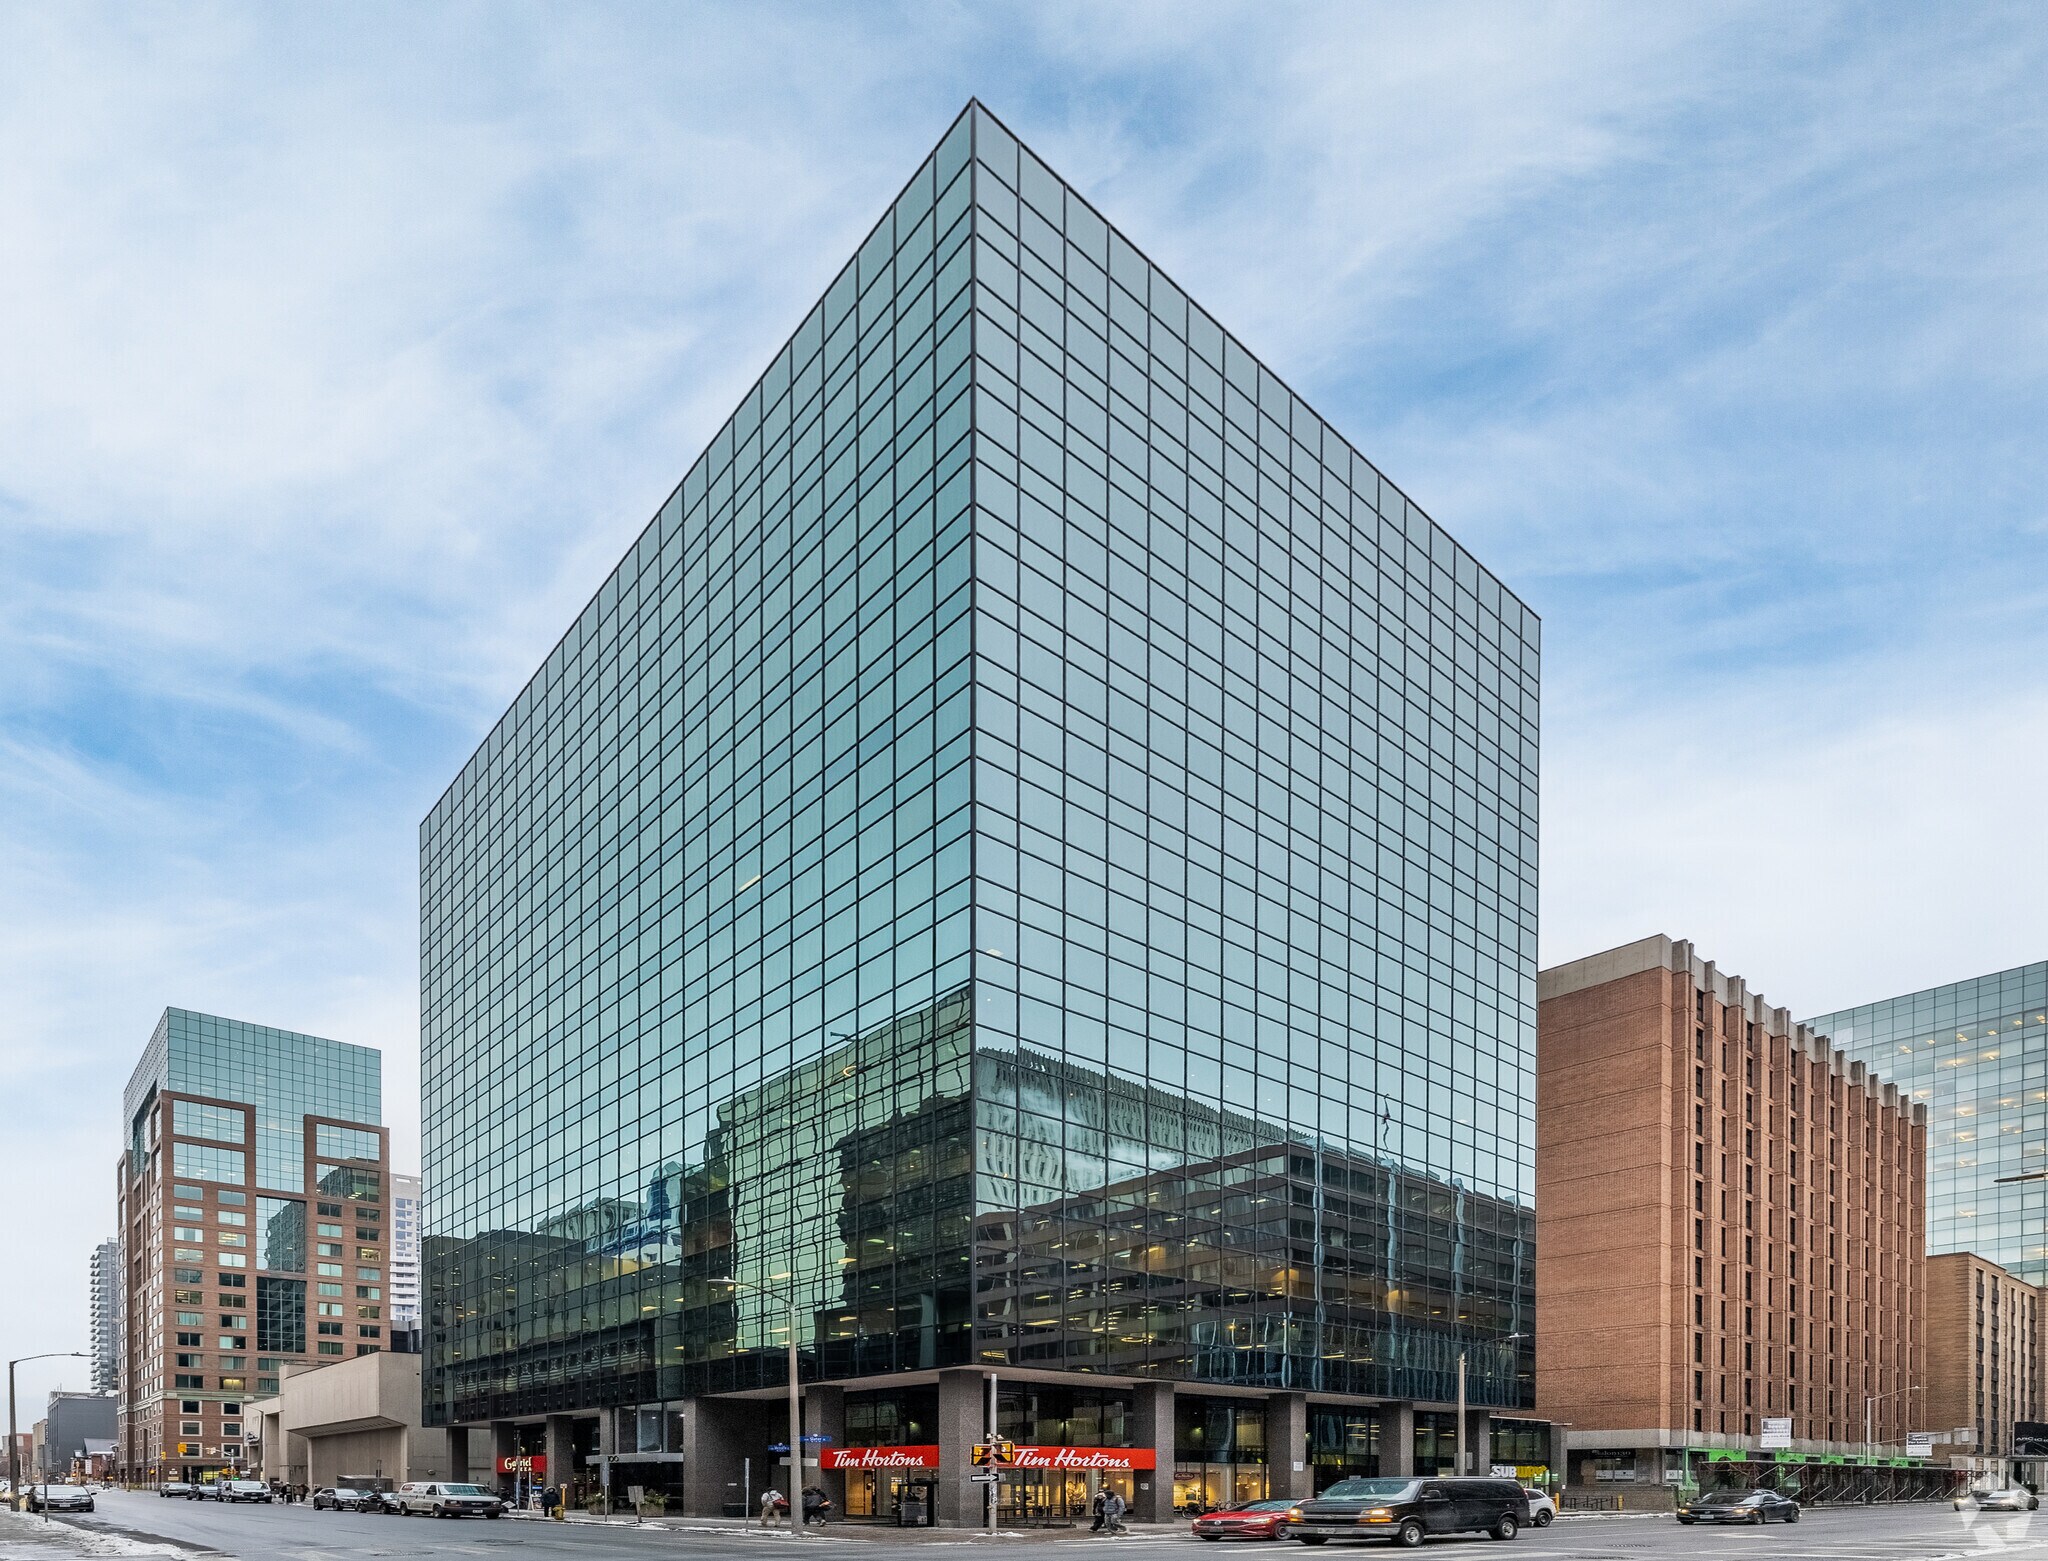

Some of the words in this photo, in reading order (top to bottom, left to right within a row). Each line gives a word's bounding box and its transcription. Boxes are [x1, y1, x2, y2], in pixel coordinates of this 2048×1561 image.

[504, 1457, 532, 1470] Gariel
[832, 1450, 860, 1467] Tim
[861, 1449, 925, 1467] Hortons
[1014, 1448, 1051, 1466] Tim
[1053, 1448, 1131, 1467] Hortons
[1489, 1464, 1548, 1478] SUBWAY
